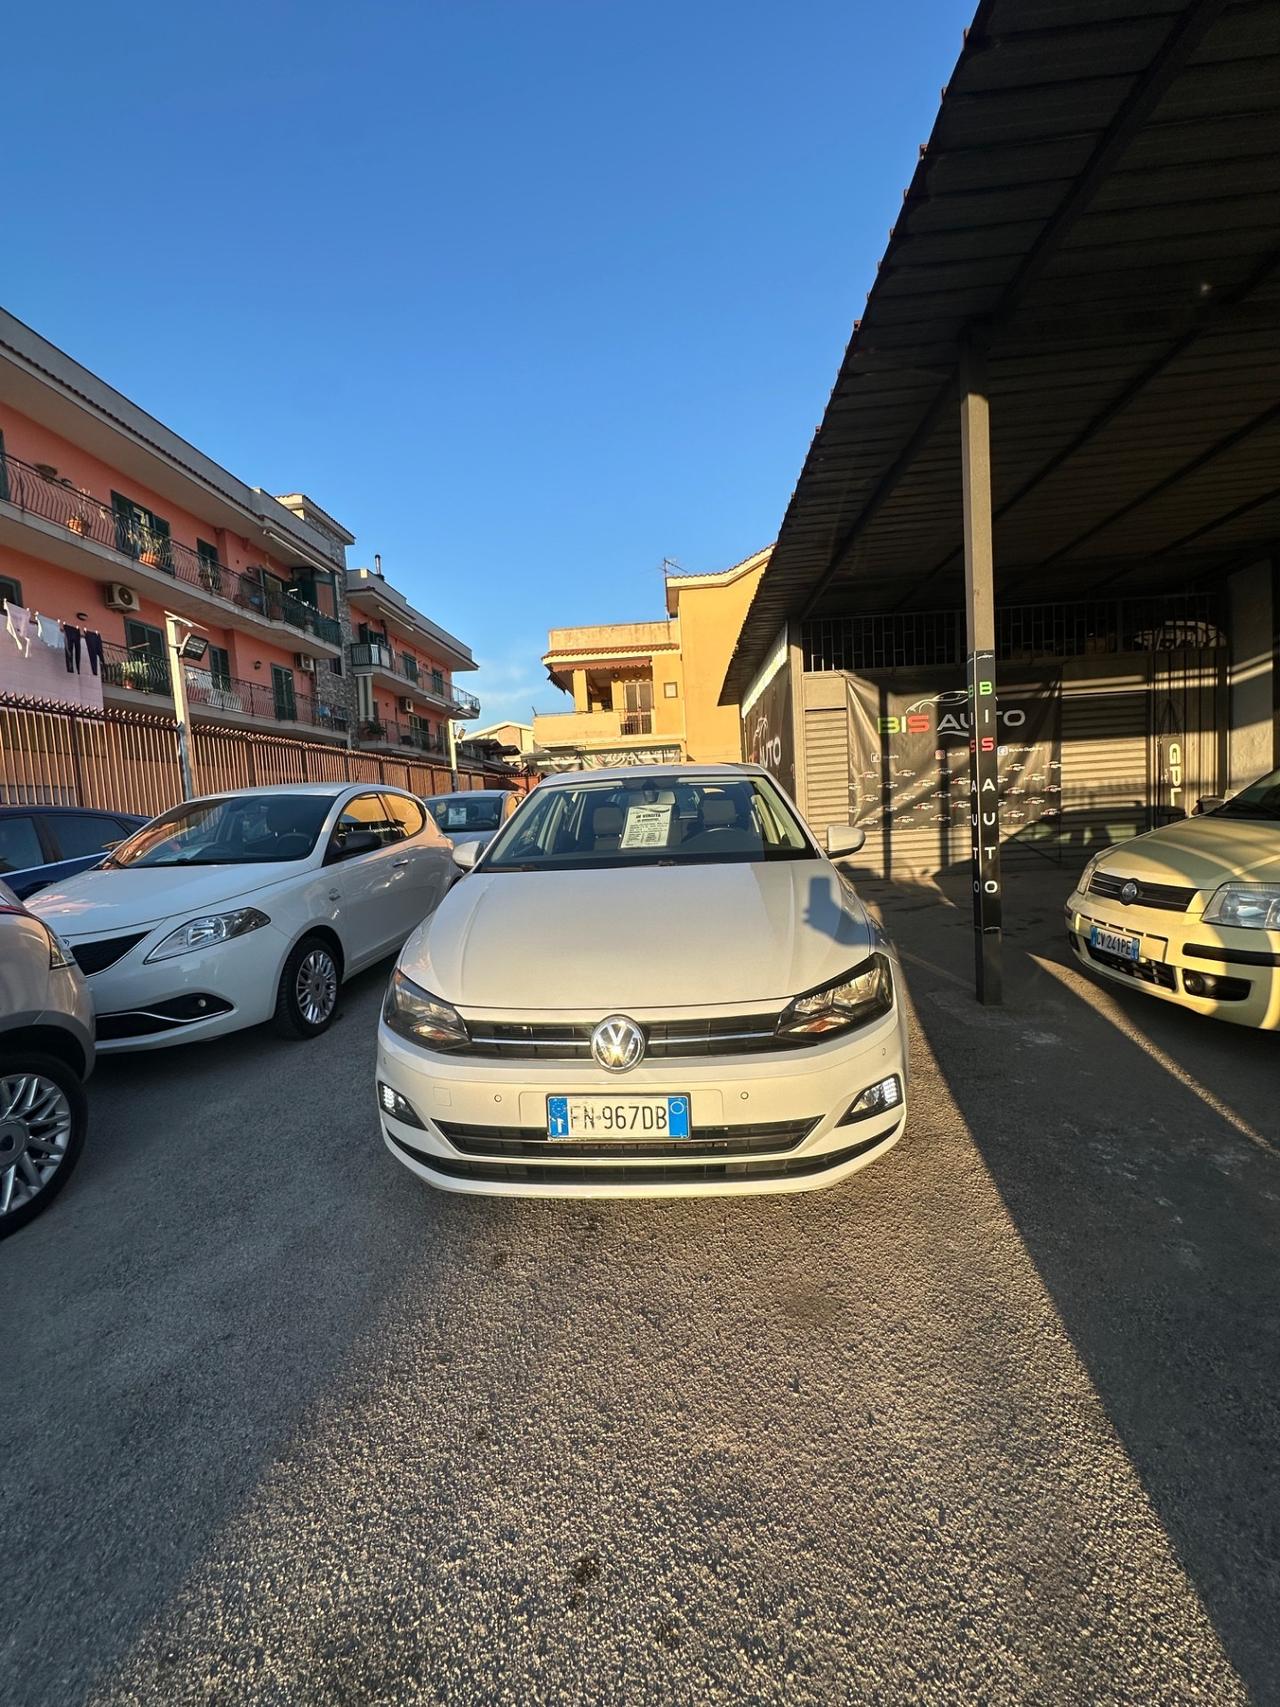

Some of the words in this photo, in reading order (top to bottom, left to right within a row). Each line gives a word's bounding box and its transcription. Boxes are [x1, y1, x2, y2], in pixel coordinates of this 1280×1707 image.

[877, 714, 930, 734] BIS
[979, 681, 994, 751] BIS
[1169, 743, 1182, 807] GPL
[982, 778, 998, 893] AUTO
[570, 1105, 595, 1130] FN
[602, 1105, 668, 1130] 967DB
